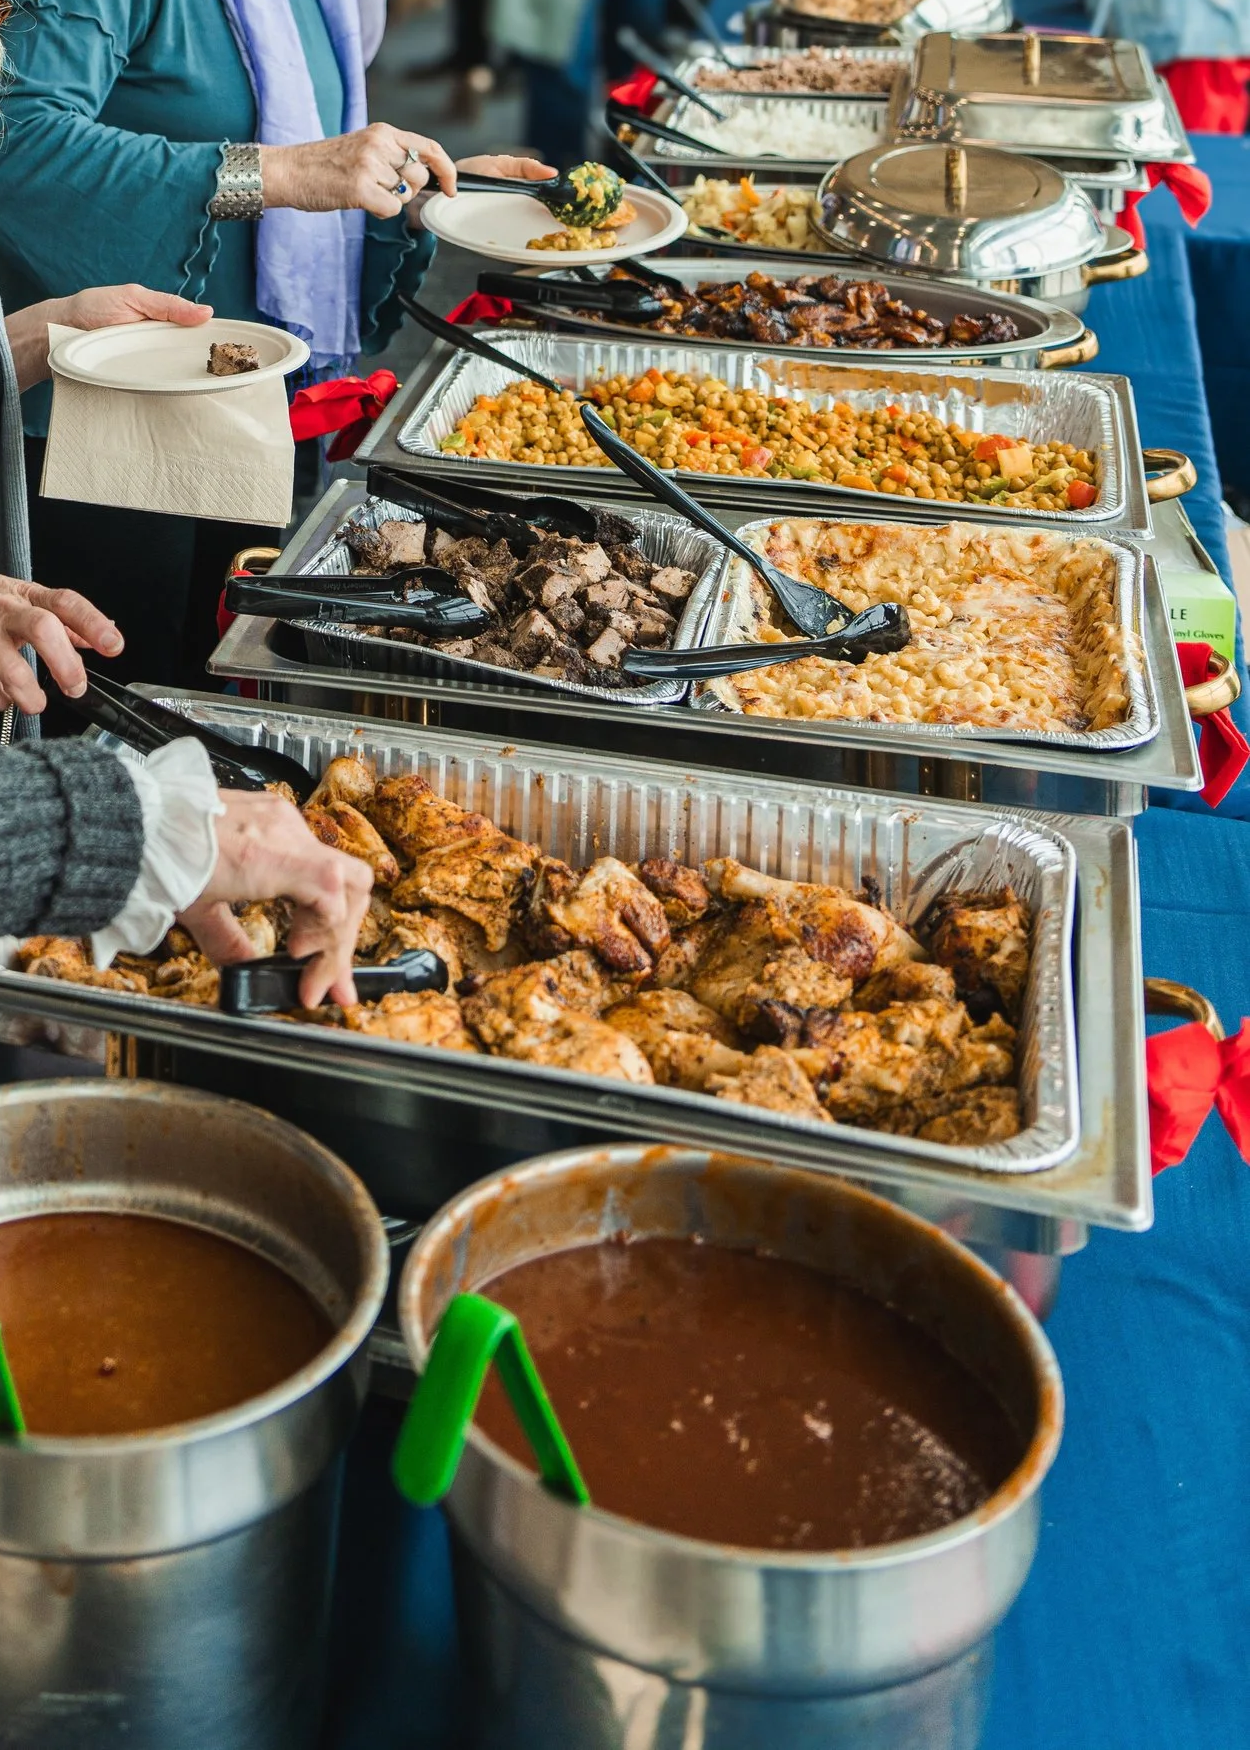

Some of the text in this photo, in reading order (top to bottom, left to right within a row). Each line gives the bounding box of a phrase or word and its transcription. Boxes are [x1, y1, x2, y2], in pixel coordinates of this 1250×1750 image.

[1170, 608, 1187, 620] LE
[1173, 629, 1225, 640] inyl Gloves
